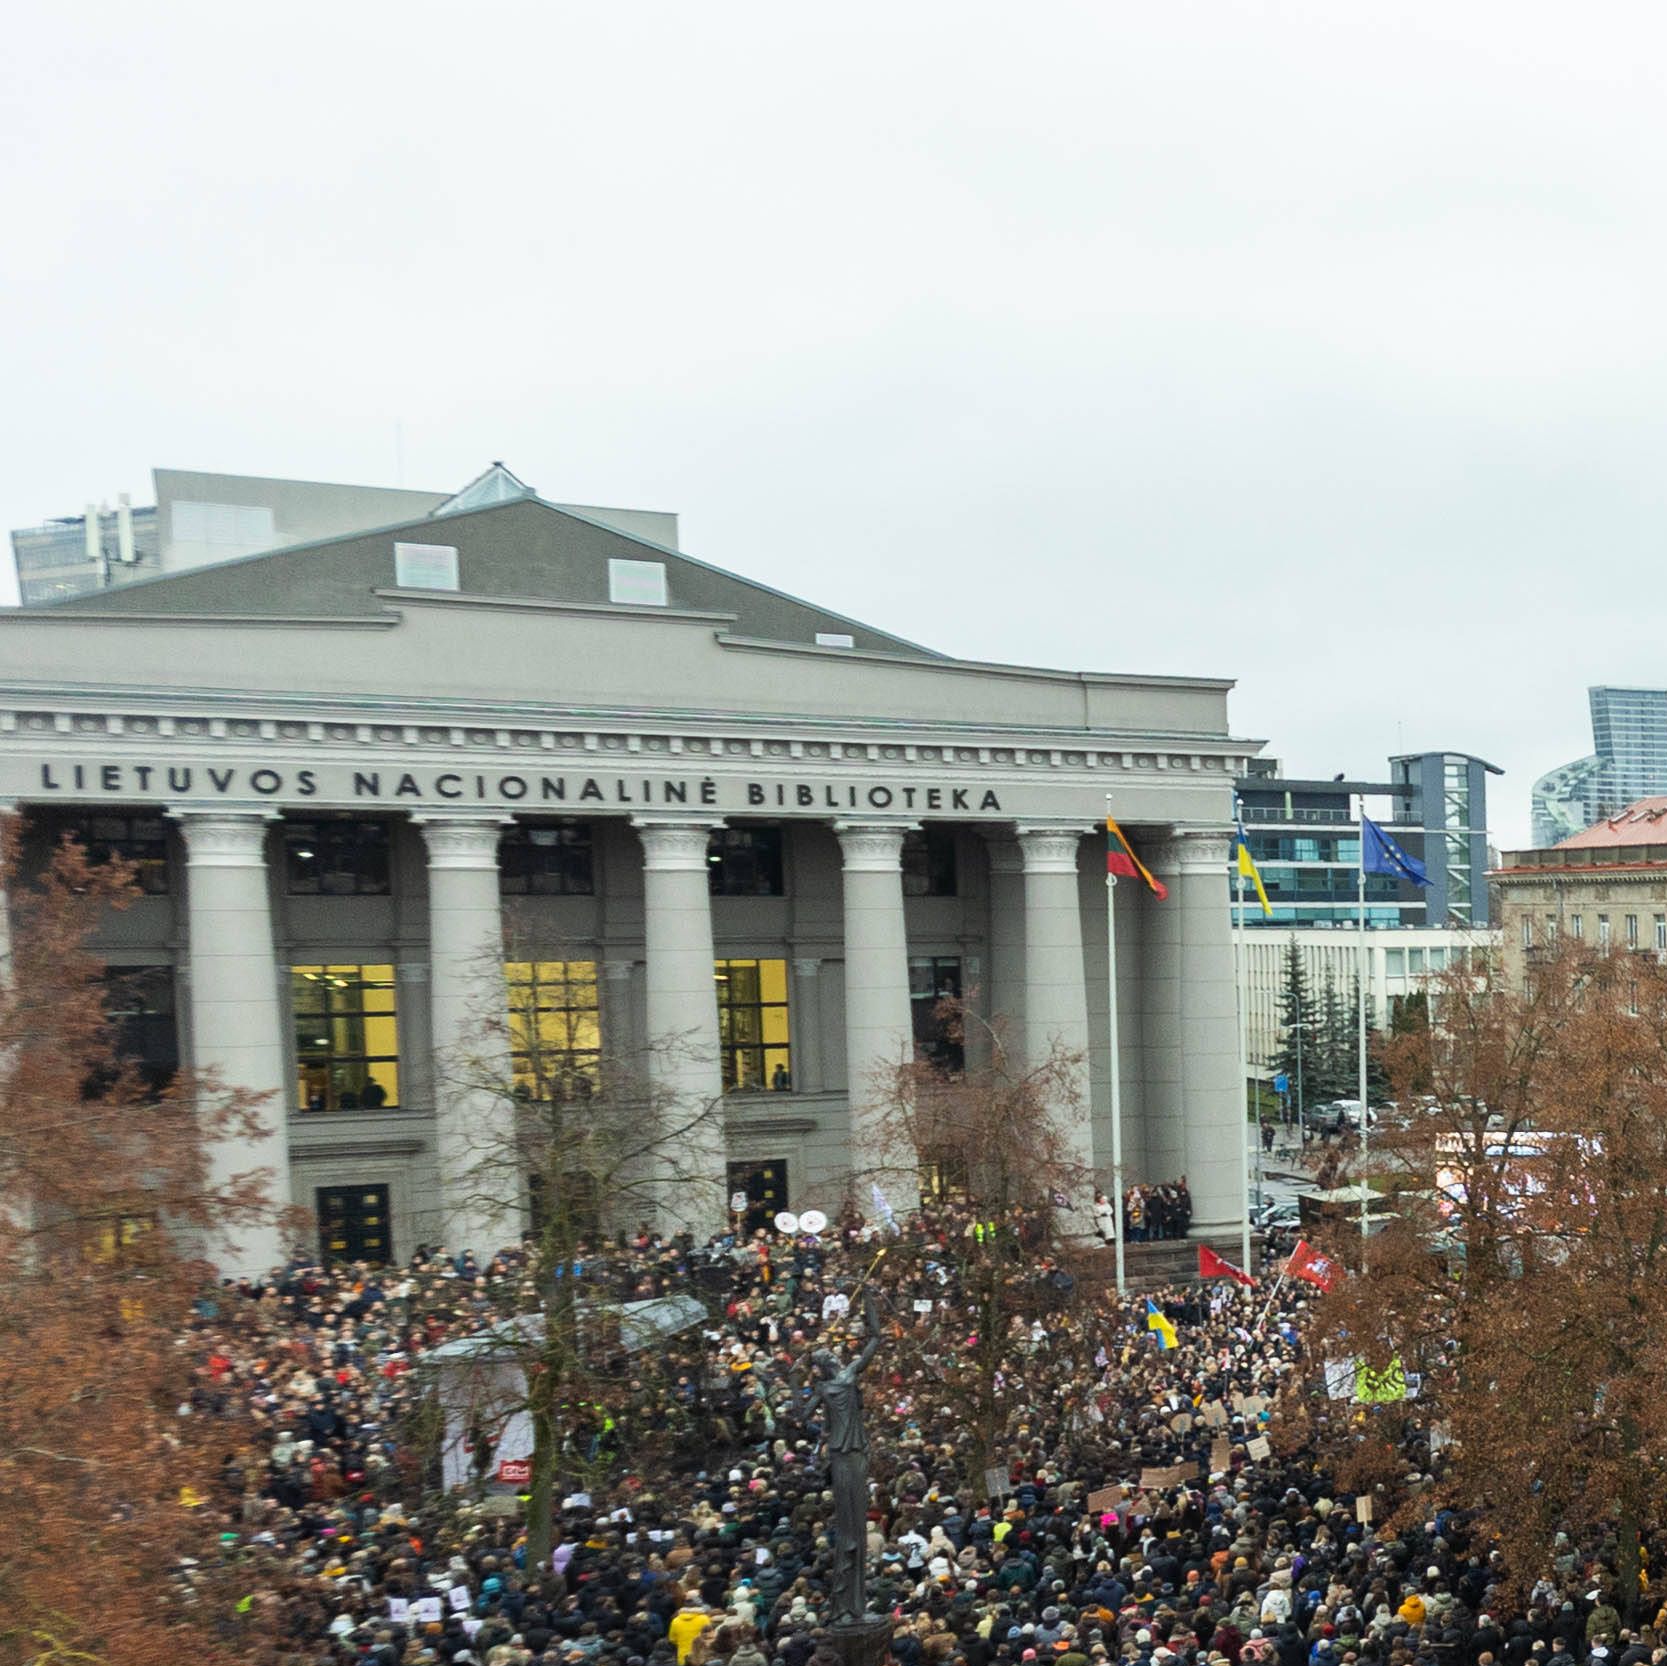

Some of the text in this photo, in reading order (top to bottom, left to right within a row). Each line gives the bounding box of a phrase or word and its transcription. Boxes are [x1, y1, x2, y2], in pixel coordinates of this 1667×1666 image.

[41, 763, 1001, 811] LIETUVOS NACIONALINĖ BIBLIOTEKA
